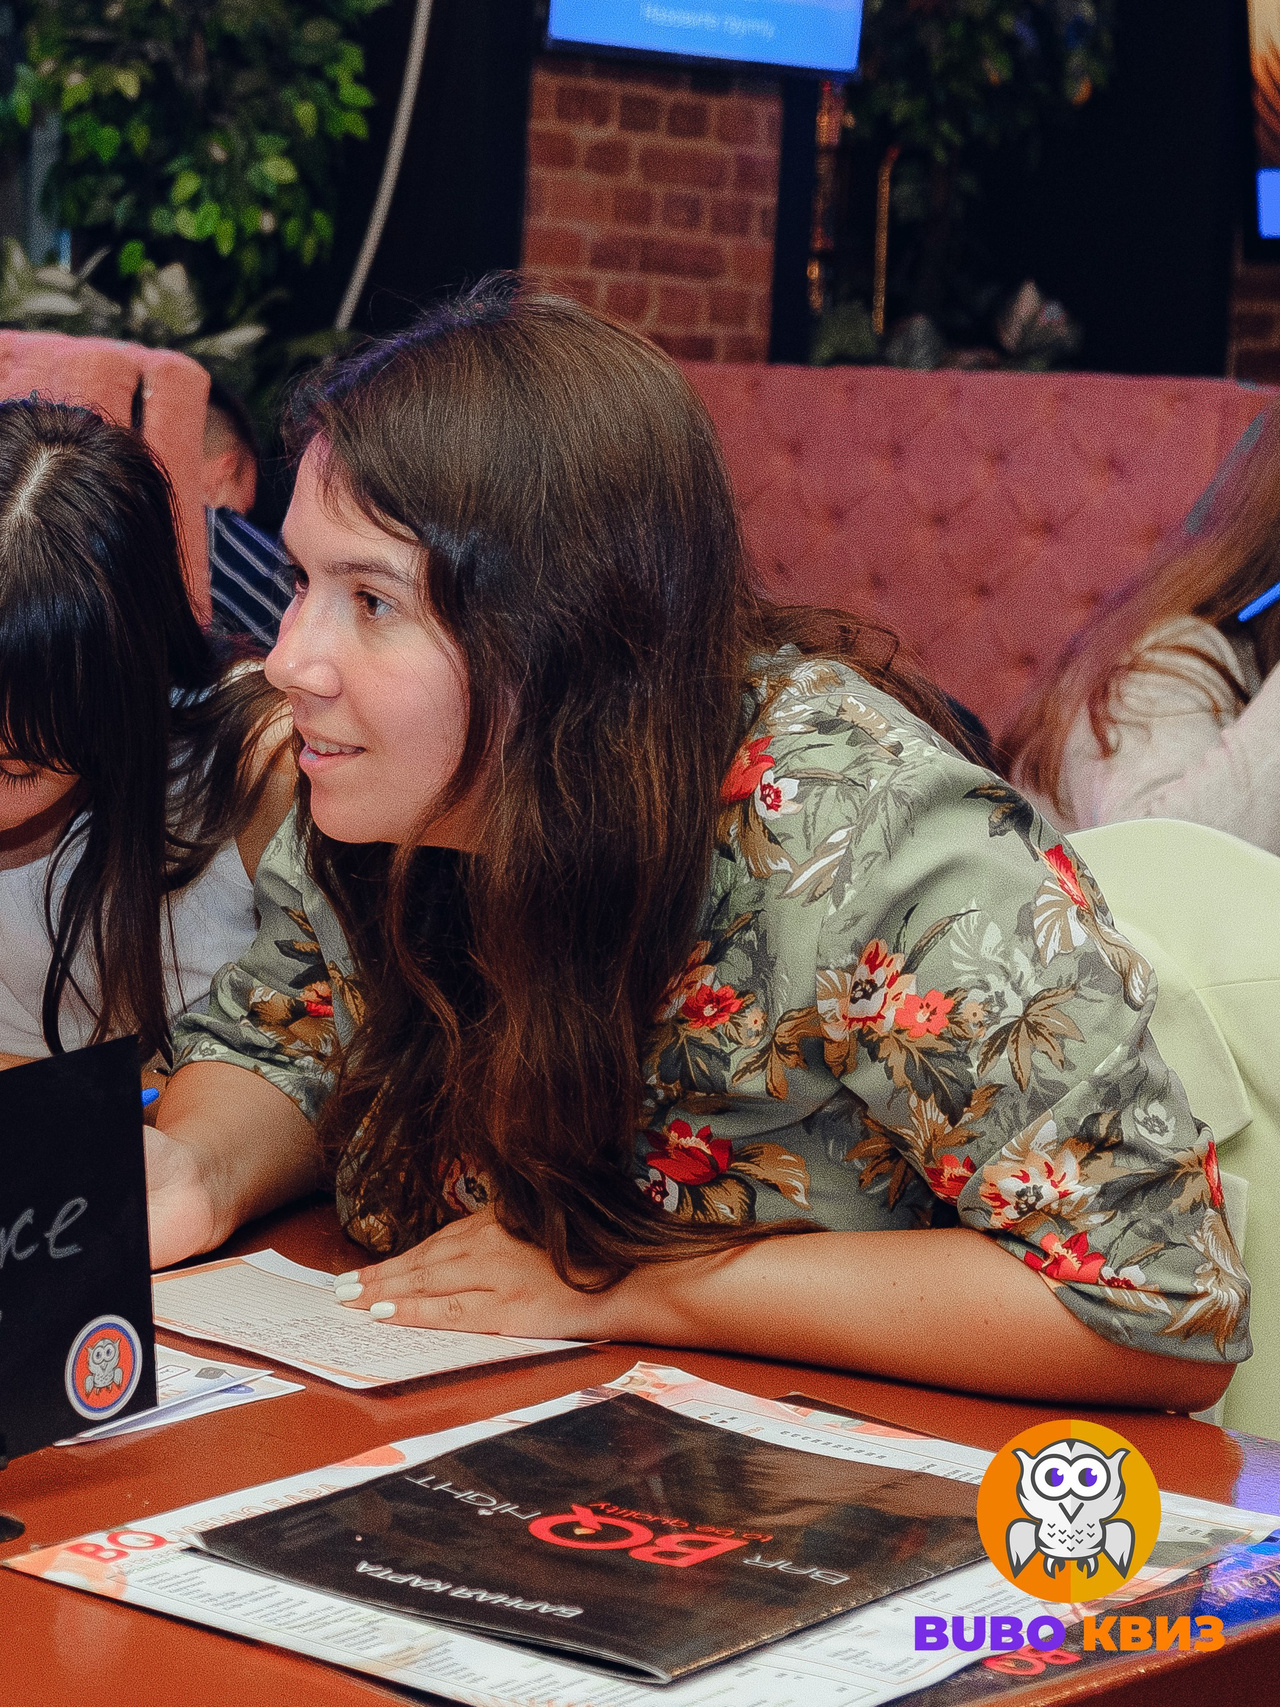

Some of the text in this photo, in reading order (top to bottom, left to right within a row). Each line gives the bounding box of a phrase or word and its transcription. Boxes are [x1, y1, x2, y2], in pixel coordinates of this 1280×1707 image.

[528, 1503, 749, 1568] BQ
[355, 1560, 584, 1618] БАРНАЯ КАРТА
